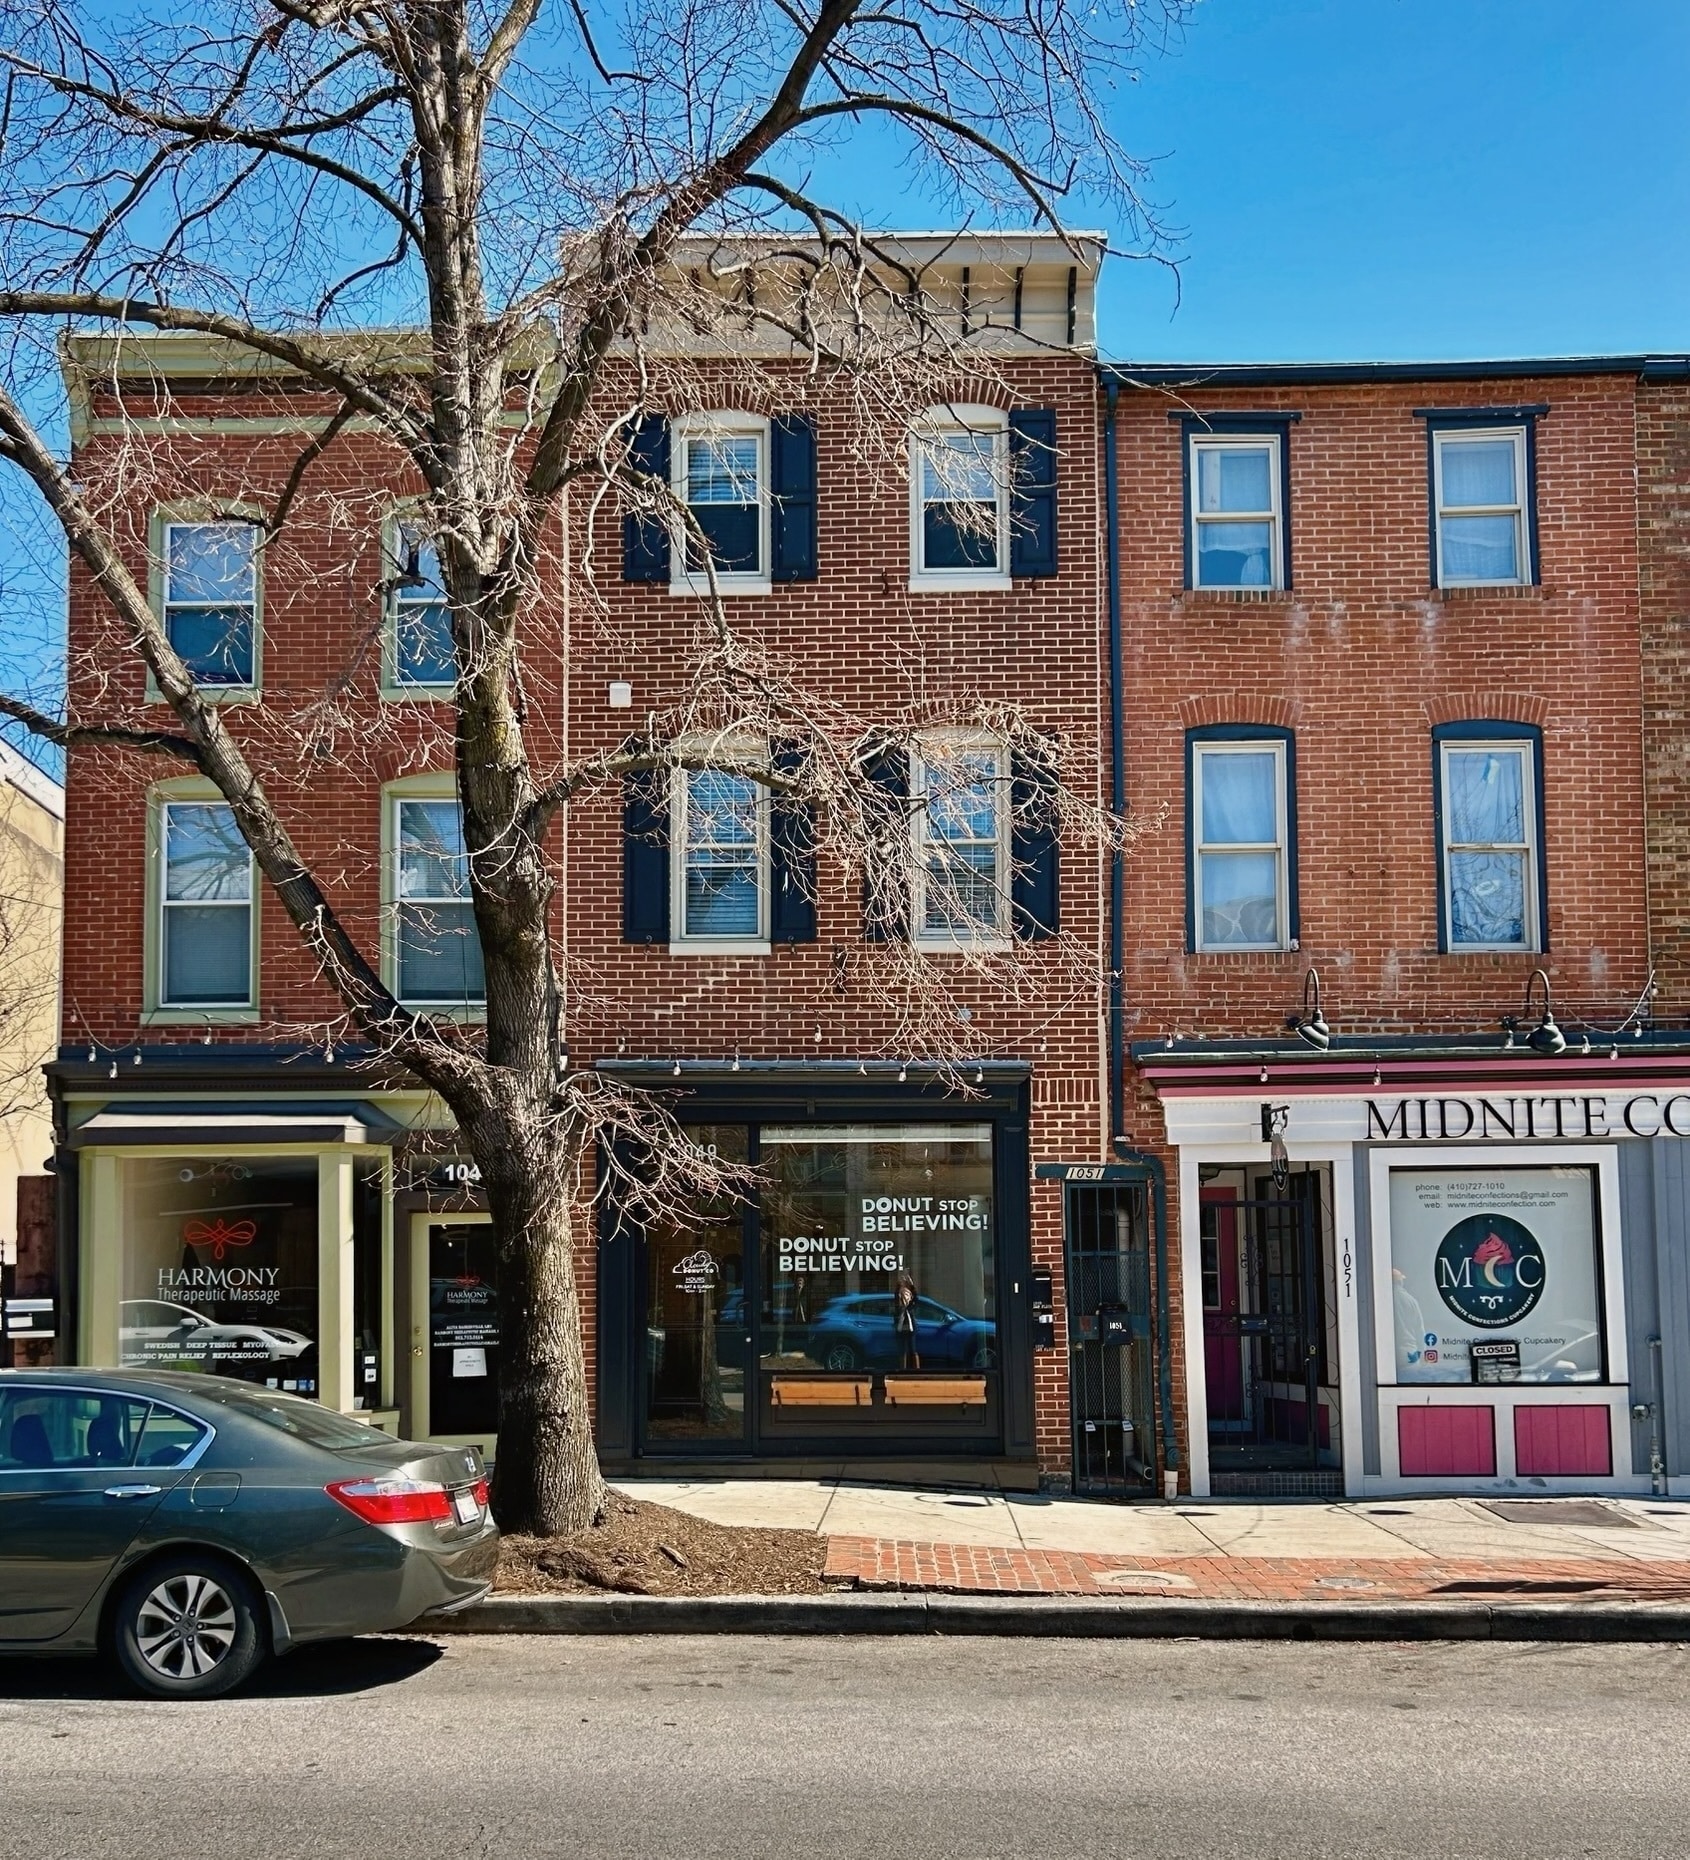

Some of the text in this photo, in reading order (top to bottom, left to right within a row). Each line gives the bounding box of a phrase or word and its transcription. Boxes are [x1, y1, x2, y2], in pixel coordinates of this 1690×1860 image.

[1364, 1095, 1690, 1139] MIDNITE CO
[1070, 1168, 1101, 1178] 1051
[1416, 1182, 1505, 1193] phone: (410)727-1010
[1418, 1191, 1568, 1200] email: midniteconfections@gmail.com
[861, 1196, 979, 1214] DONUT STOP
[1424, 1201, 1443, 1209] web:
[862, 1214, 988, 1233] BELIEVING!
[779, 1236, 894, 1253] DONUT STOP
[779, 1254, 904, 1272] BELIEVING!
[1343, 1238, 1351, 1298] 1051
[1439, 1255, 1542, 1288] M C
[158, 1266, 280, 1289] HARMONY
[158, 1287, 280, 1305] Therapeutic Massage
[447, 1290, 487, 1299] HARMONY
[1523, 1337, 1567, 1346] Cupcakery
[121, 1352, 157, 1360] CHRONIC
[158, 1352, 178, 1360] PAIN
[178, 1352, 206, 1360] RELIEF
[1475, 1346, 1513, 1355] CLOSED
